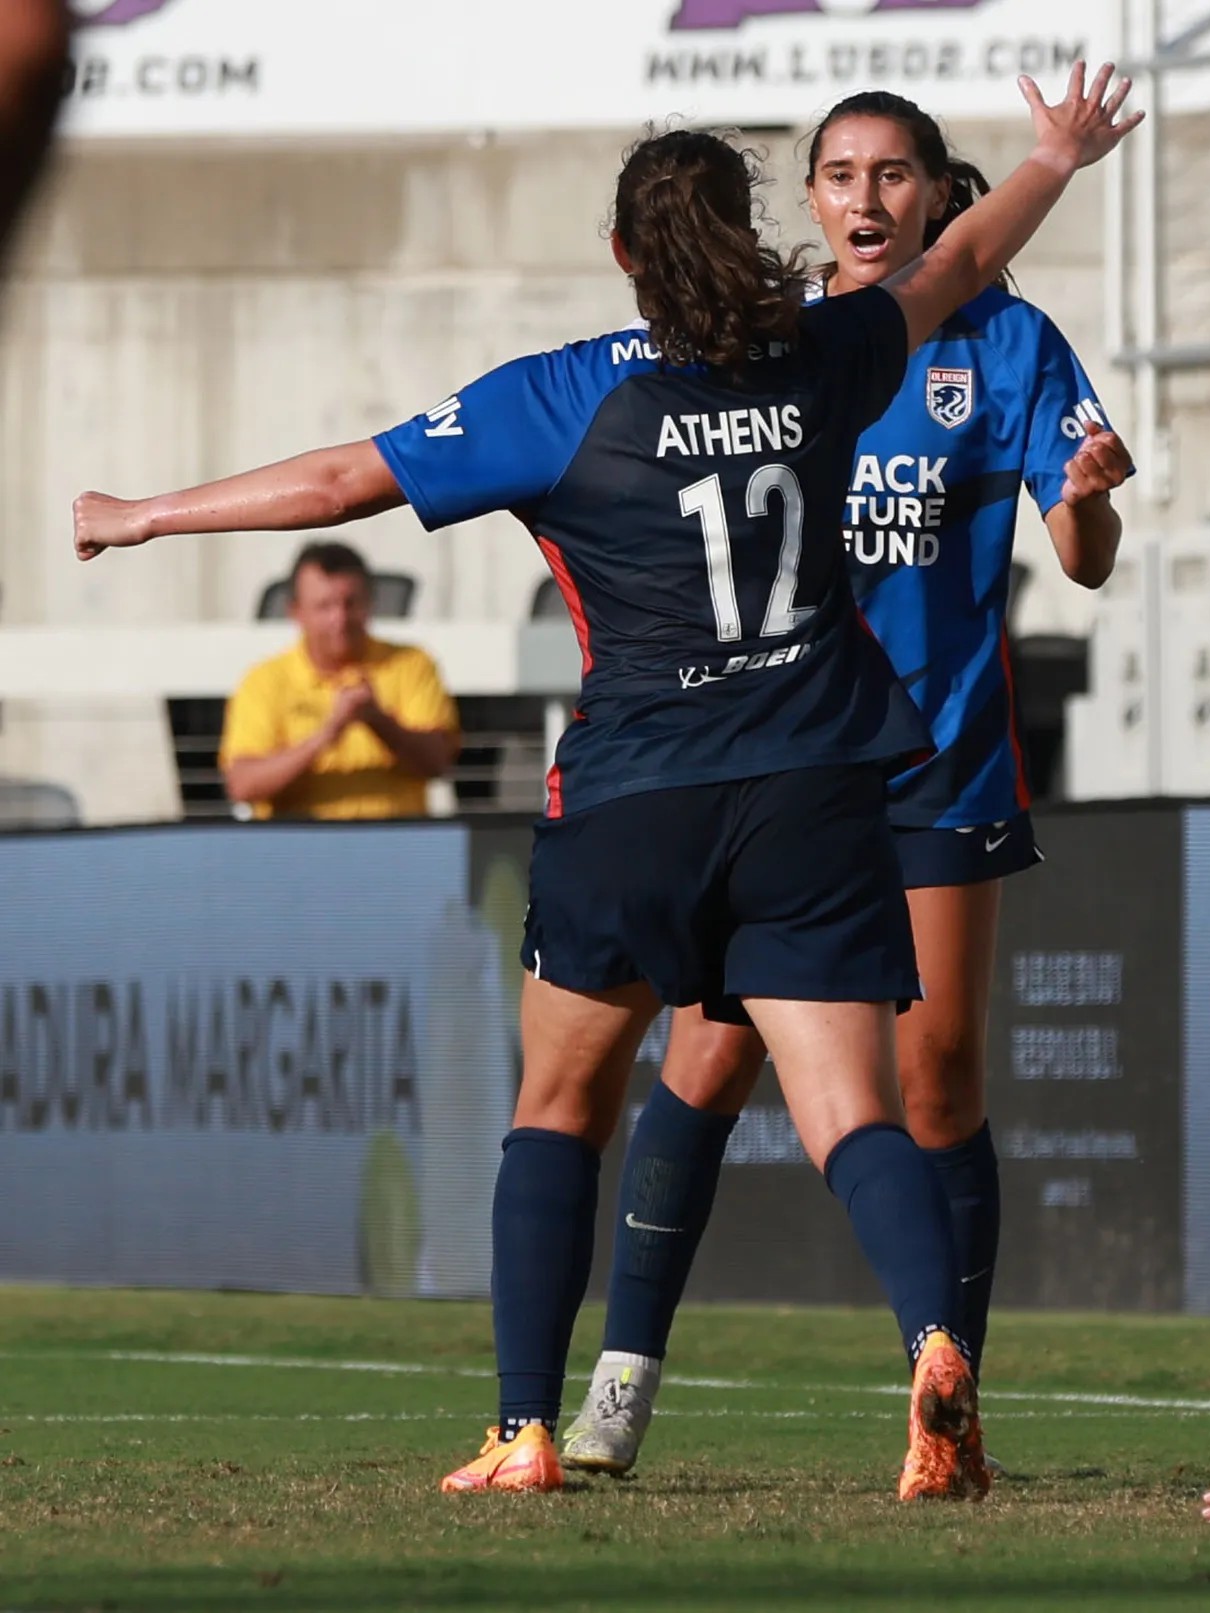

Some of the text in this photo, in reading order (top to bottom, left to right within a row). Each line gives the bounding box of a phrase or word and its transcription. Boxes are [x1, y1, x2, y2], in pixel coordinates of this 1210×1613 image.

[424, 396, 464, 437] lly
[657, 405, 803, 458] ATHENS
[678, 463, 818, 642] 12
